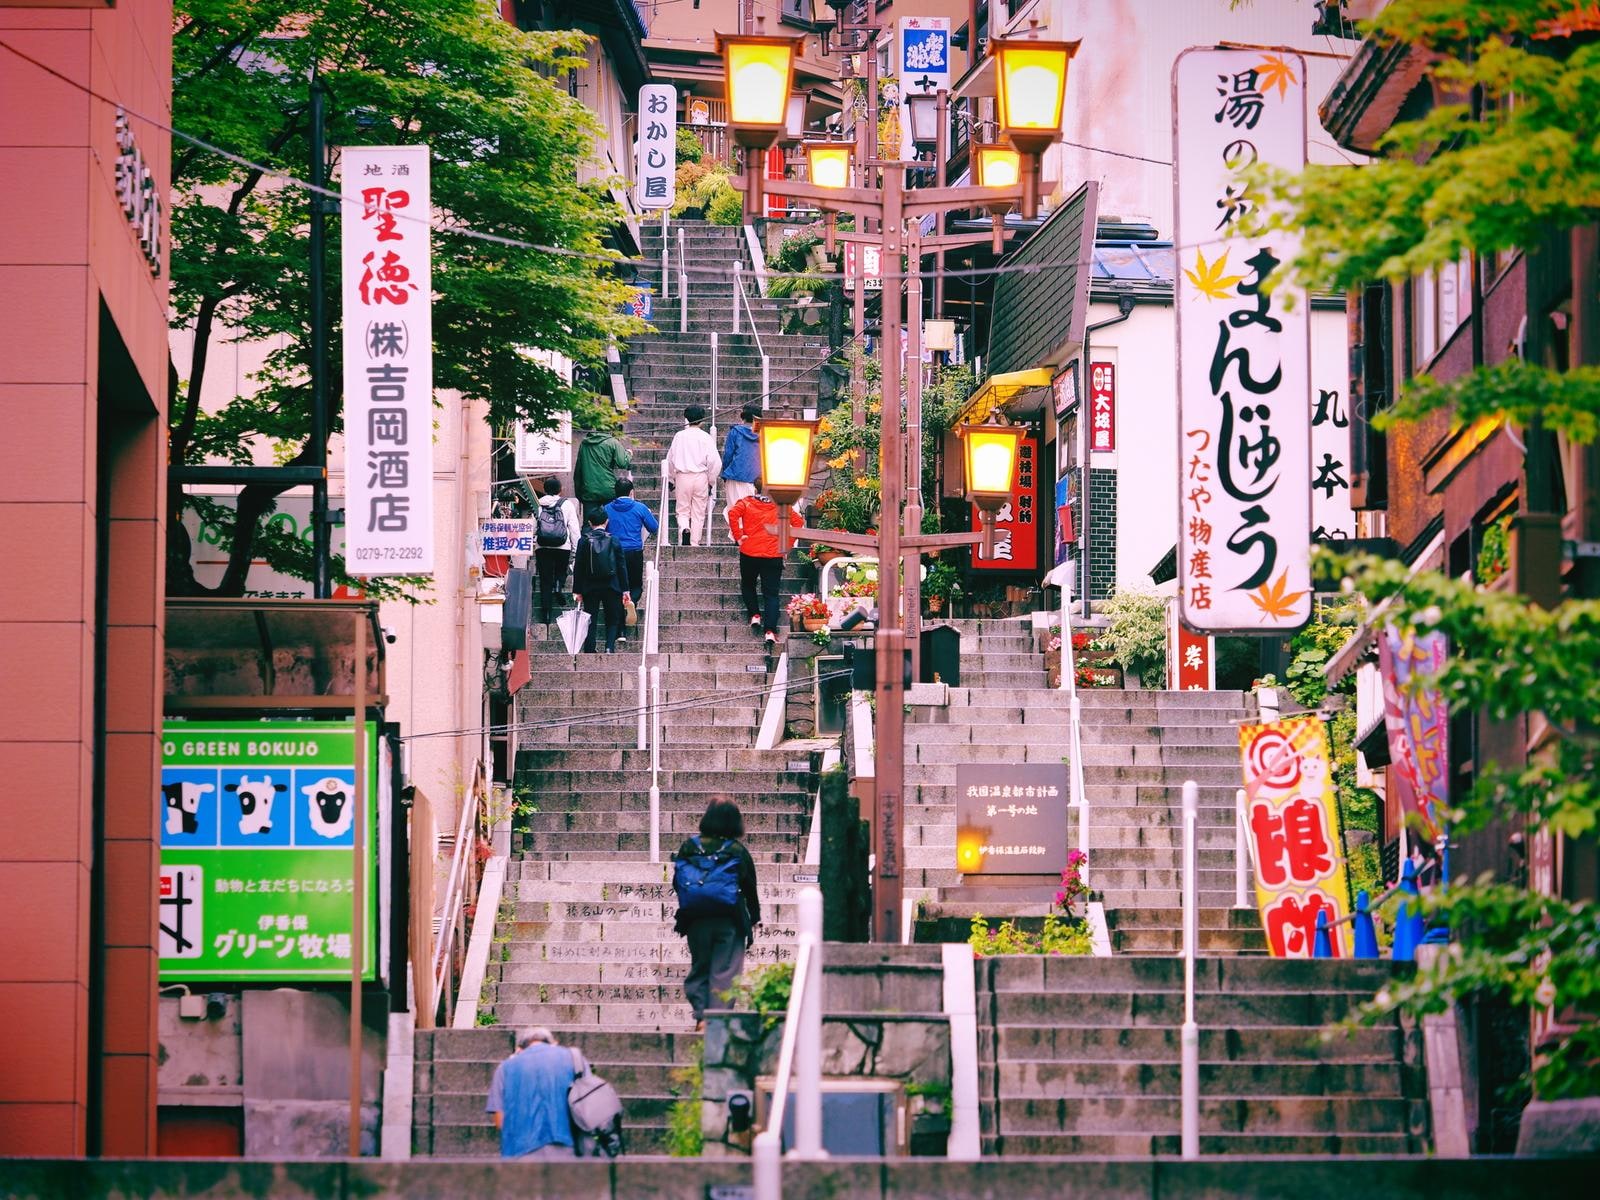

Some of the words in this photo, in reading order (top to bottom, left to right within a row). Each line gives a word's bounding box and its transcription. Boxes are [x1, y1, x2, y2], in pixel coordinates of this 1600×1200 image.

[645, 94, 668, 197] おかし屋
[363, 164, 410, 176] 地酒
[358, 187, 418, 305] 聖徳
[1209, 248, 1282, 591] まんじゅう
[1019, 446, 1032, 488] 遊技場
[1019, 495, 1032, 523] 射的
[1187, 429, 1212, 609] つたや物産店
[356, 548, 423, 560] 0279-72-2292
[483, 537, 531, 550] 推奨の店
[183, 742, 240, 756] GREEN
[966, 785, 1059, 798] 我国温泉都市計画
[986, 804, 1038, 817] 第一号の地
[258, 915, 308, 930] 伊香保
[214, 930, 352, 958] グリーン牧場
